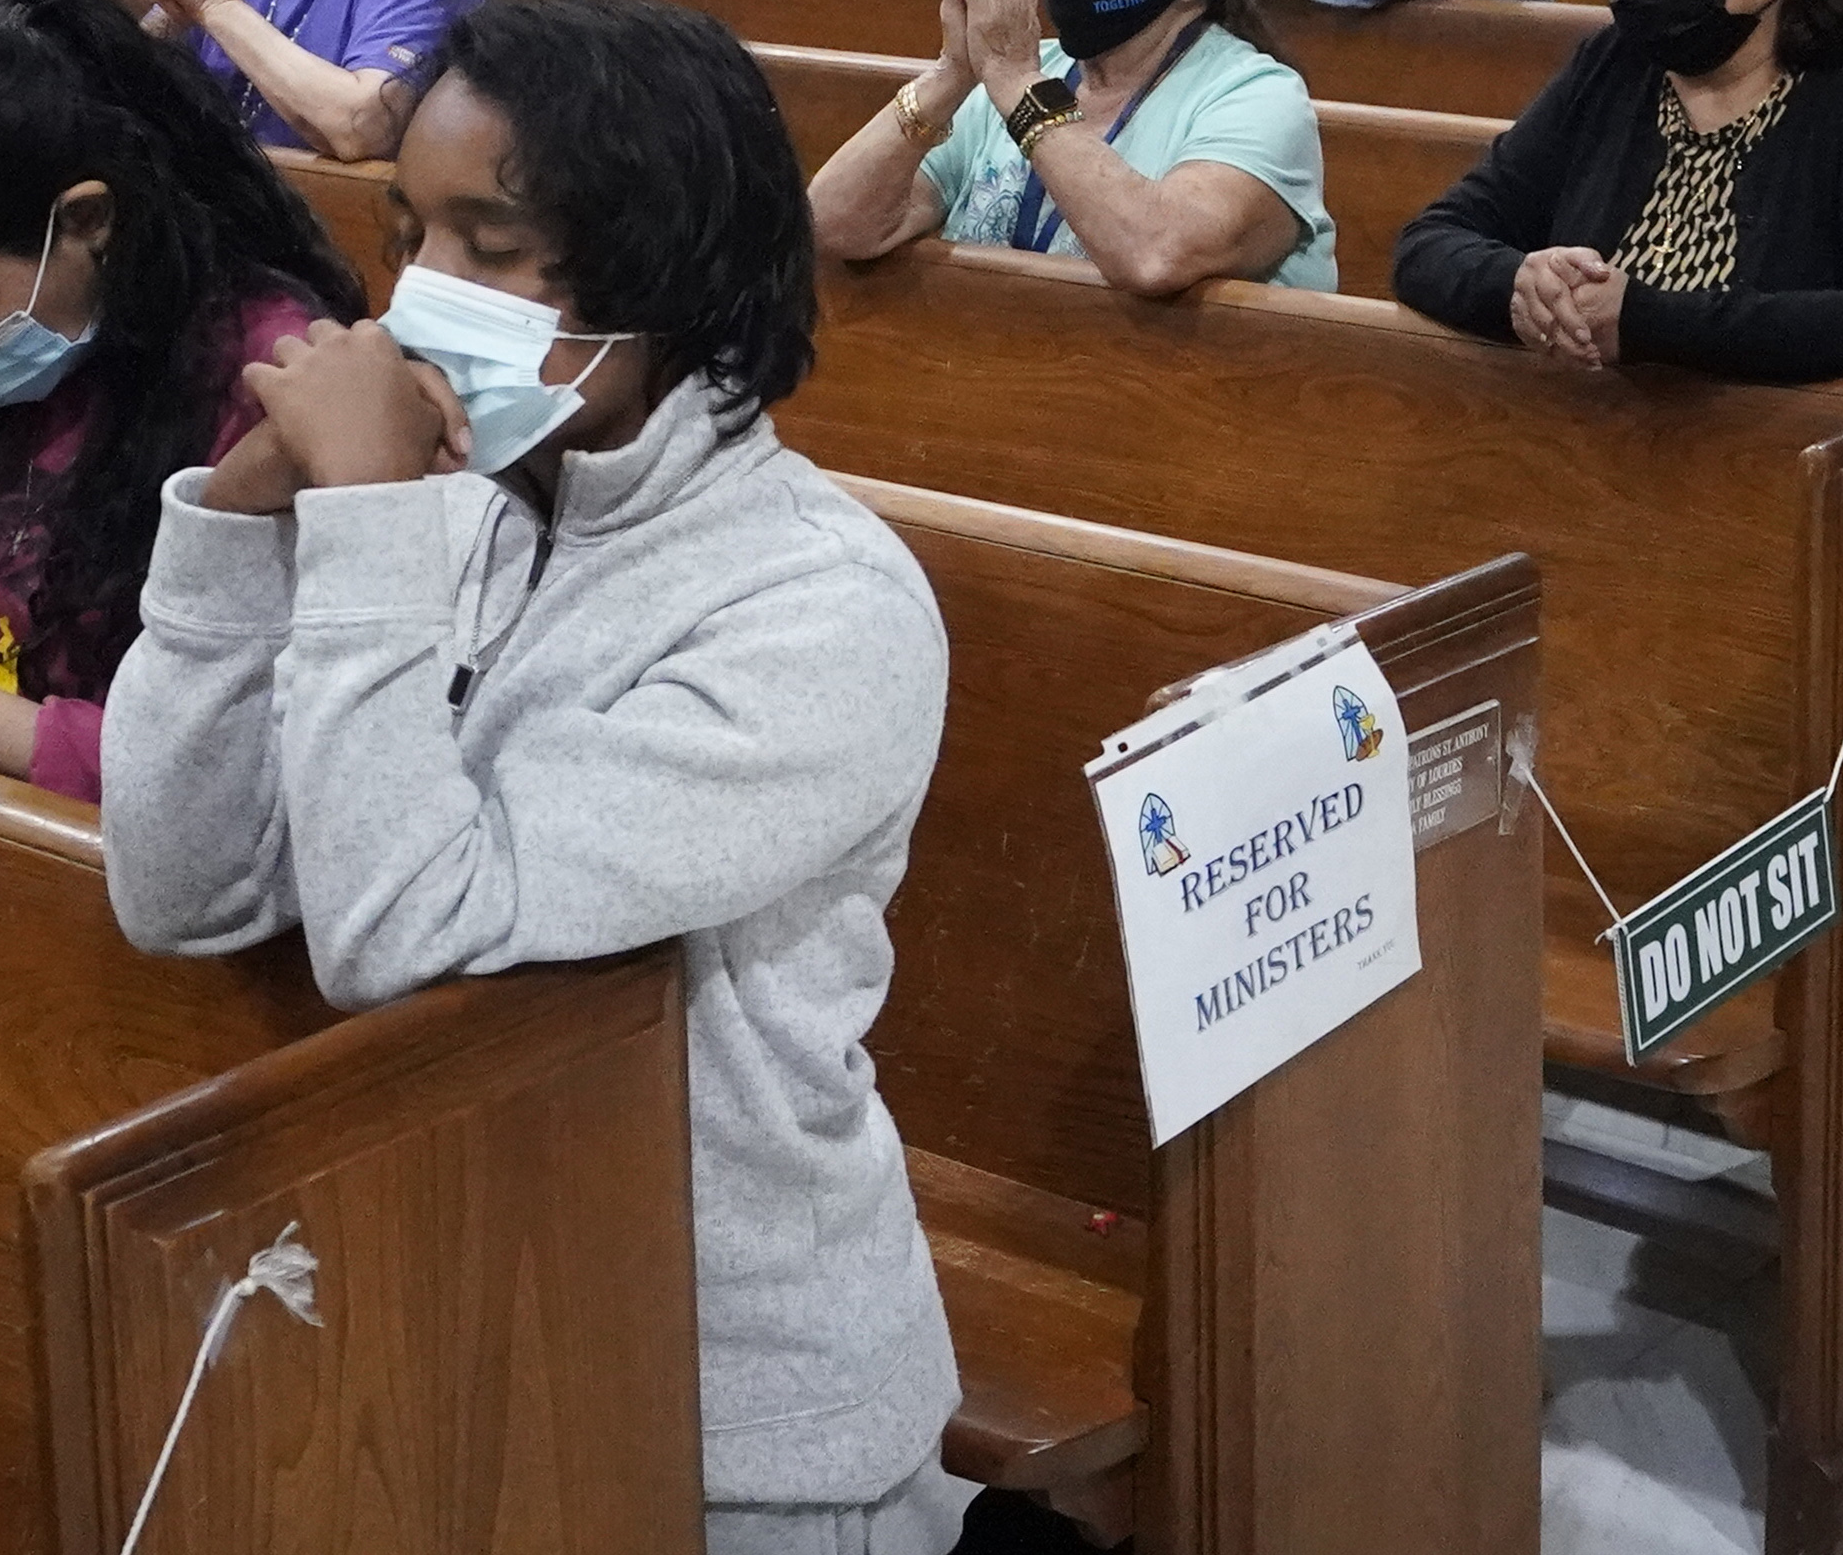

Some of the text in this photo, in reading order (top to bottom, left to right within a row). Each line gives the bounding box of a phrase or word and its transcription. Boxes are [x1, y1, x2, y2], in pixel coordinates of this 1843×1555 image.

[1455, 722, 1490, 752] ANTHONY
[1417, 774, 1428, 789] OF
[1428, 756, 1464, 784] LOURDES
[1180, 782, 1364, 914] RESERVED
[1419, 807, 1447, 835] FAMILY
[1245, 871, 1313, 937] FOR
[1638, 830, 1821, 1023] DO NOT SIT
[1194, 893, 1374, 1033] MINISTERS
